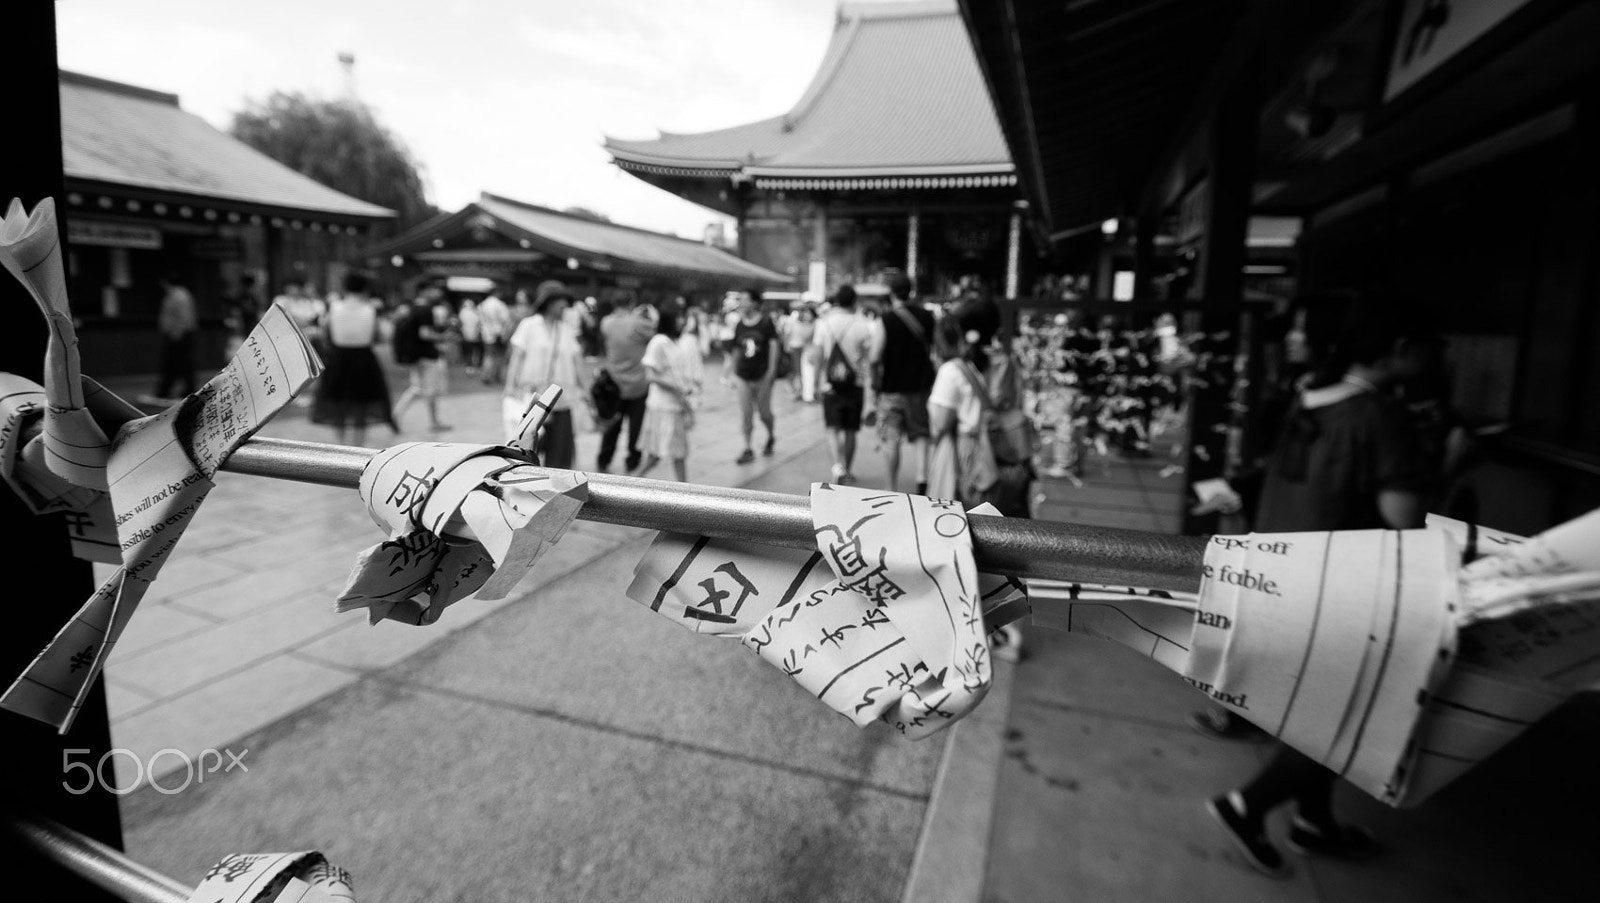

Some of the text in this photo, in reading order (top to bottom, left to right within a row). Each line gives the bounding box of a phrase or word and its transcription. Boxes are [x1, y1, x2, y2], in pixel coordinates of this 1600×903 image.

[135, 498, 152, 515] will
[152, 489, 169, 504] not
[169, 483, 183, 495] be
[151, 522, 166, 536] to
[165, 503, 195, 527] envy
[1257, 541, 1295, 556] off
[127, 558, 152, 578] you
[1218, 564, 1282, 597] fable.
[683, 561, 760, 625] 凶
